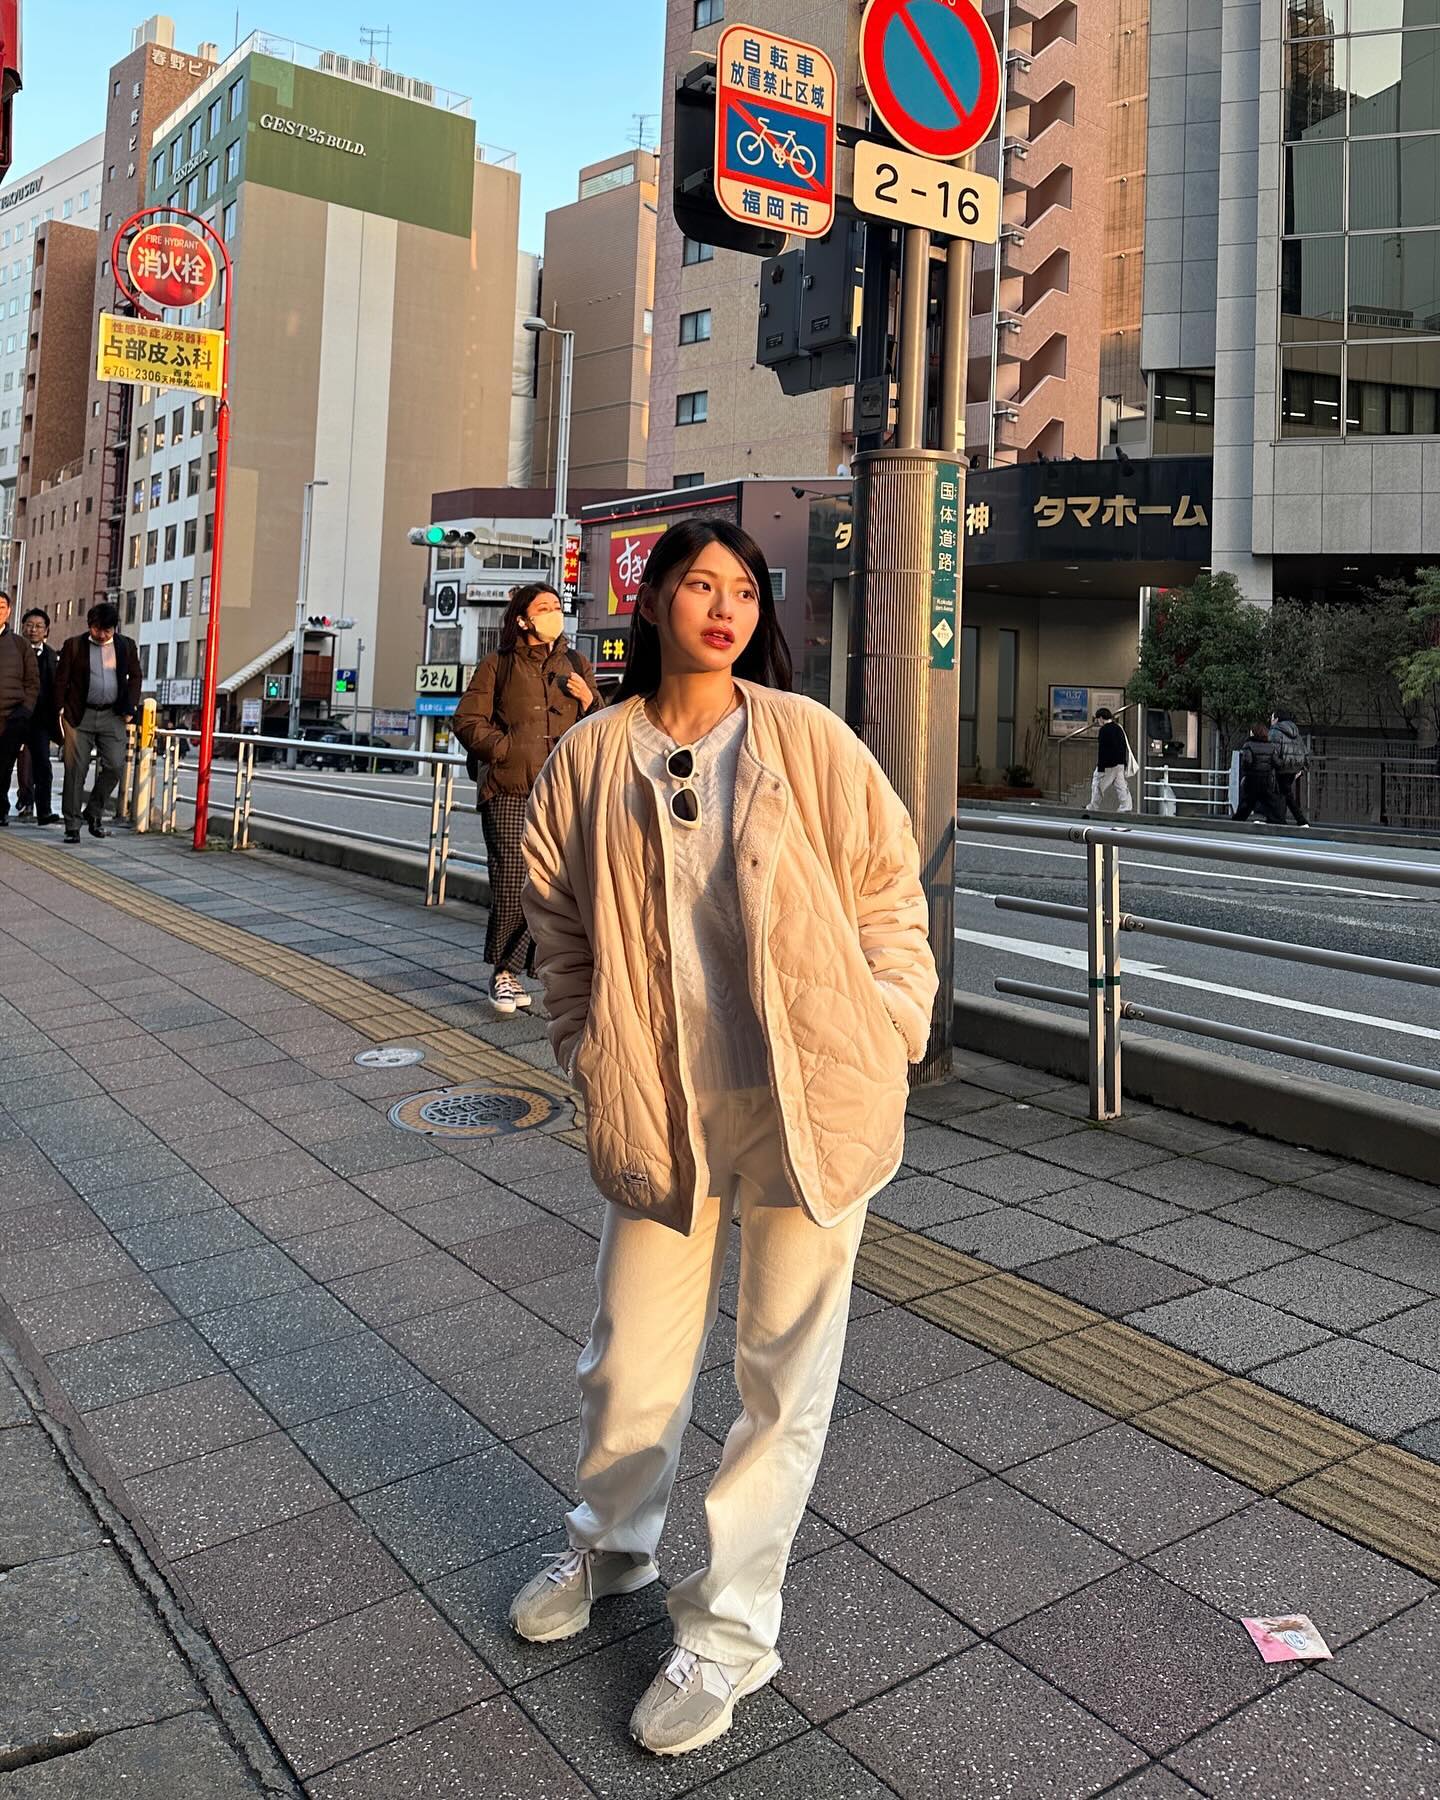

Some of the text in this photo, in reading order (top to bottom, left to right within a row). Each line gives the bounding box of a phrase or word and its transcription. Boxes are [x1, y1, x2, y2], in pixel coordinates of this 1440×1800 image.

[744, 39, 814, 78] 自転車
[731, 60, 825, 110] 放置禁止区域
[742, 188, 809, 226] 福岡市
[875, 163, 980, 225] 2-16
[145, 233, 200, 249] FIRE HYDRANT
[137, 246, 207, 286] 消火栓
[104, 335, 213, 371] 占部皮ふ科
[938, 481, 954, 571] 国体道路
[966, 501, 990, 536] 神
[1034, 494, 1208, 528] タマホーム
[616, 537, 651, 587] すき
[602, 638, 624, 660] 牛丼
[420, 668, 454, 689] うどん
